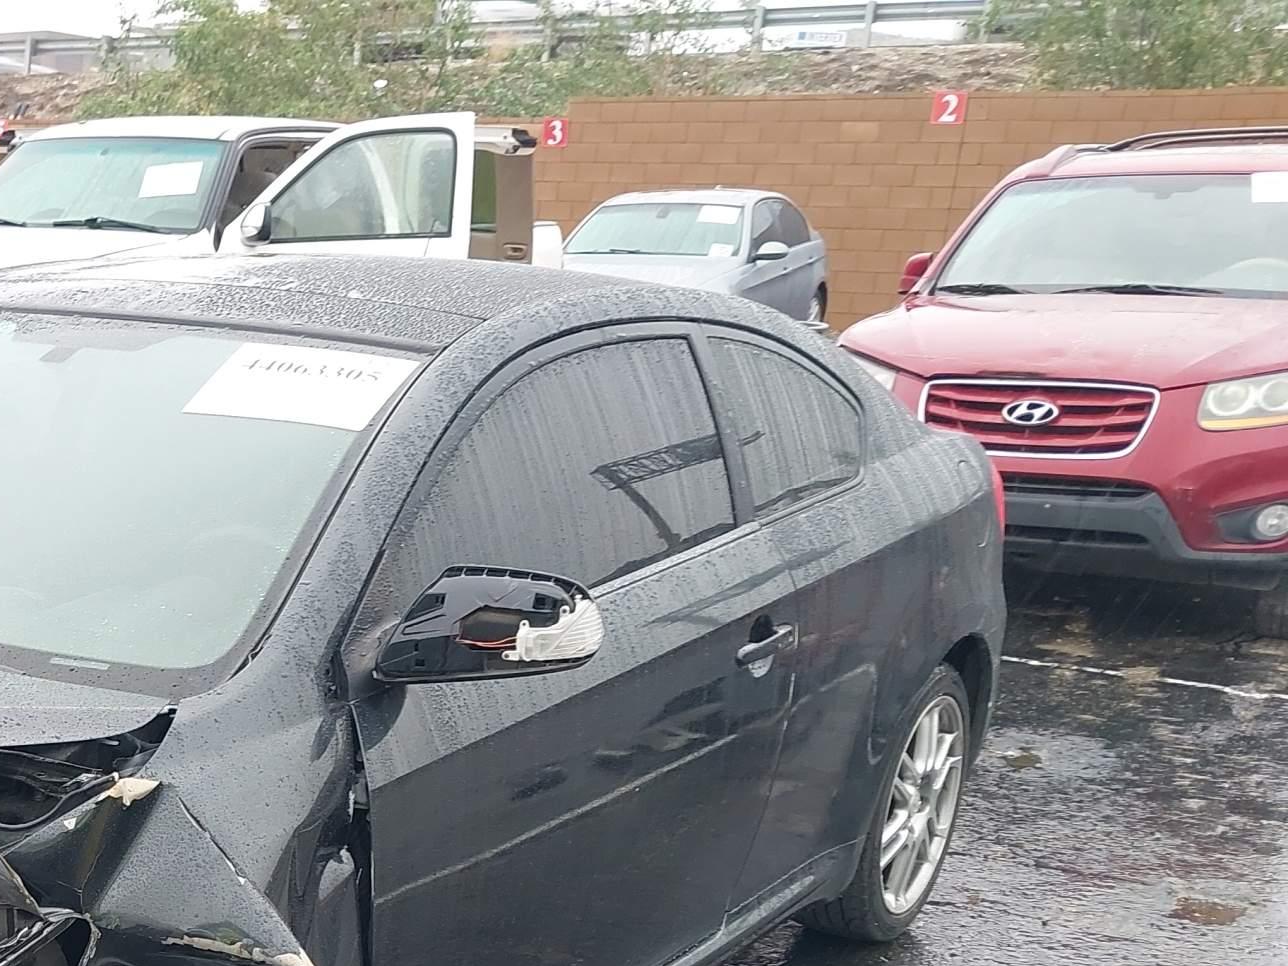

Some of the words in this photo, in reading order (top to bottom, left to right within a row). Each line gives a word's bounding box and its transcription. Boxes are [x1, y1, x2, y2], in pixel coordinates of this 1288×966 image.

[937, 94, 959, 122] 2
[547, 120, 563, 145] 3
[243, 358, 383, 383] 44063305
